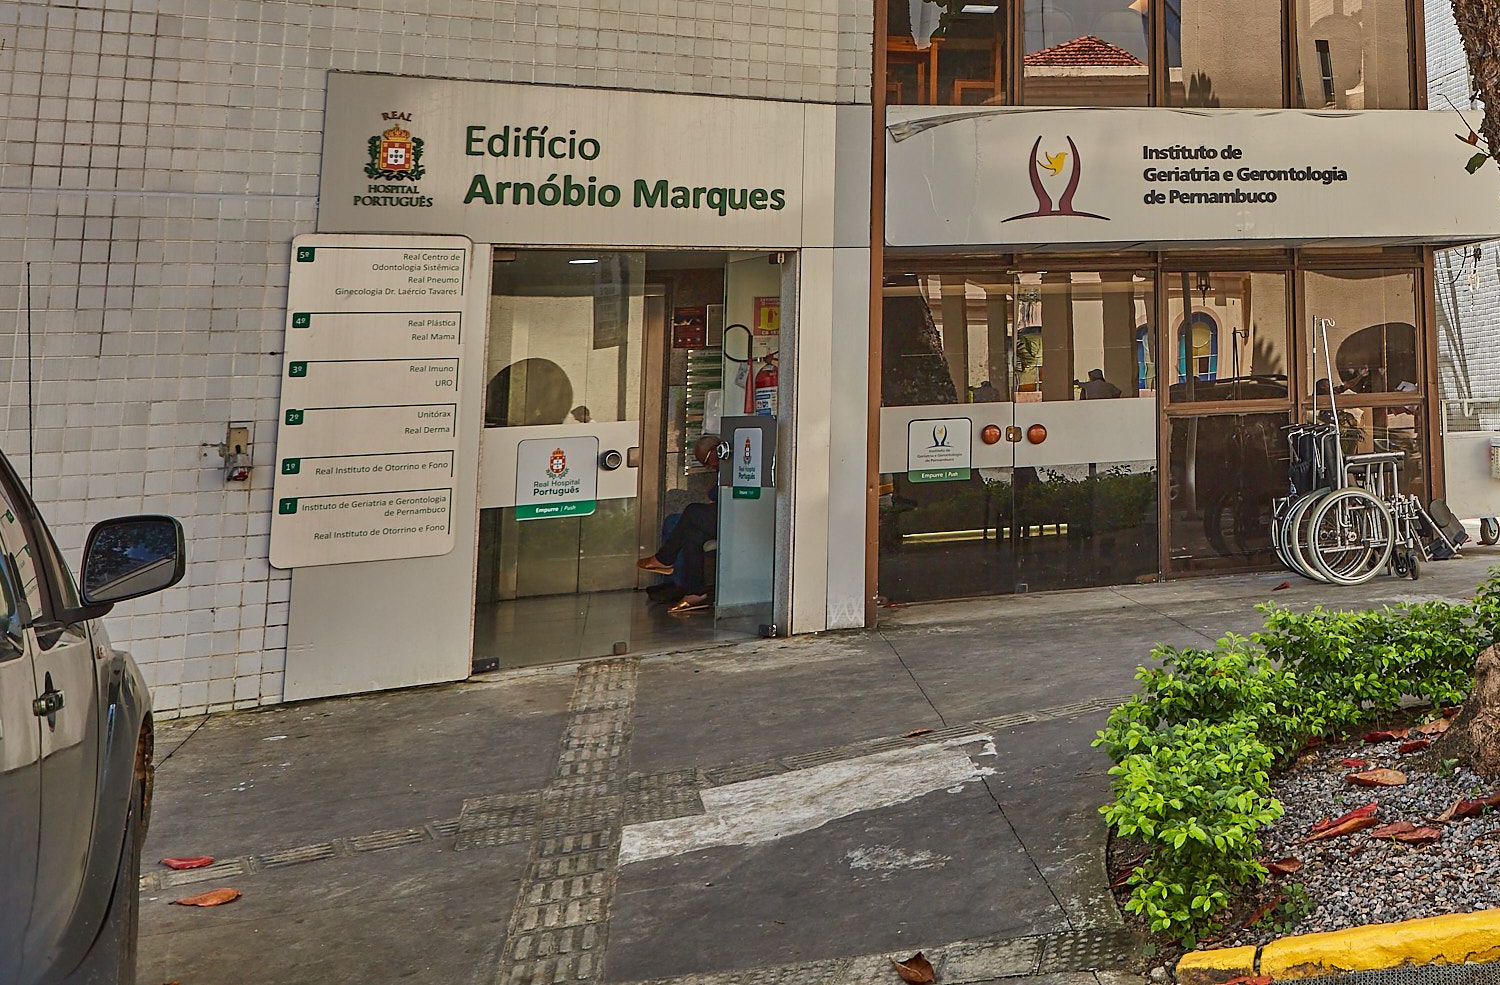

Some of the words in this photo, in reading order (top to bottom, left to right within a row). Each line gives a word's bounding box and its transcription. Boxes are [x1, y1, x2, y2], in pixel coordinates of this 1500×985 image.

[381, 111, 412, 122] REAL
[465, 125, 601, 162] Edifício
[1143, 145, 1218, 160] Instituto
[1220, 145, 1243, 160] de
[1143, 167, 1220, 181] Geriatria
[1223, 170, 1233, 181] e
[1237, 166, 1348, 185] Gerontologia
[368, 184, 419, 195] HOSPITAL
[353, 194, 434, 208] PORTUGUÊS
[463, 174, 621, 208] Arnóbio
[632, 178, 786, 217] Marques
[1143, 189, 1165, 204] de
[1169, 188, 1277, 204] Pernambuco
[403, 253, 421, 261] Real
[422, 253, 448, 261] Centro
[450, 253, 460, 261] de
[372, 264, 421, 273] Odontologia
[423, 263, 459, 271] Sistêmica
[335, 288, 382, 297] Ginecologia
[427, 319, 456, 327] Plástica
[417, 410, 451, 419] Unitórax
[424, 426, 450, 434] Derma
[315, 468, 333, 476] Real
[335, 465, 370, 474] Instituto
[385, 463, 419, 472] Otorrino
[429, 461, 448, 469] Fono
[552, 479, 580, 487] Hospital
[533, 486, 579, 496] Português
[302, 503, 337, 511] Instituto
[339, 501, 349, 509] de
[351, 499, 386, 508] Geriatria
[395, 495, 446, 506] Gerontologia
[384, 509, 394, 517] de
[396, 506, 446, 516] Pernambuco
[314, 532, 331, 540] Real
[334, 529, 368, 539] Instituto
[370, 528, 380, 536] de
[382, 526, 416, 535] Otorrino
[425, 524, 445, 532] Fono
